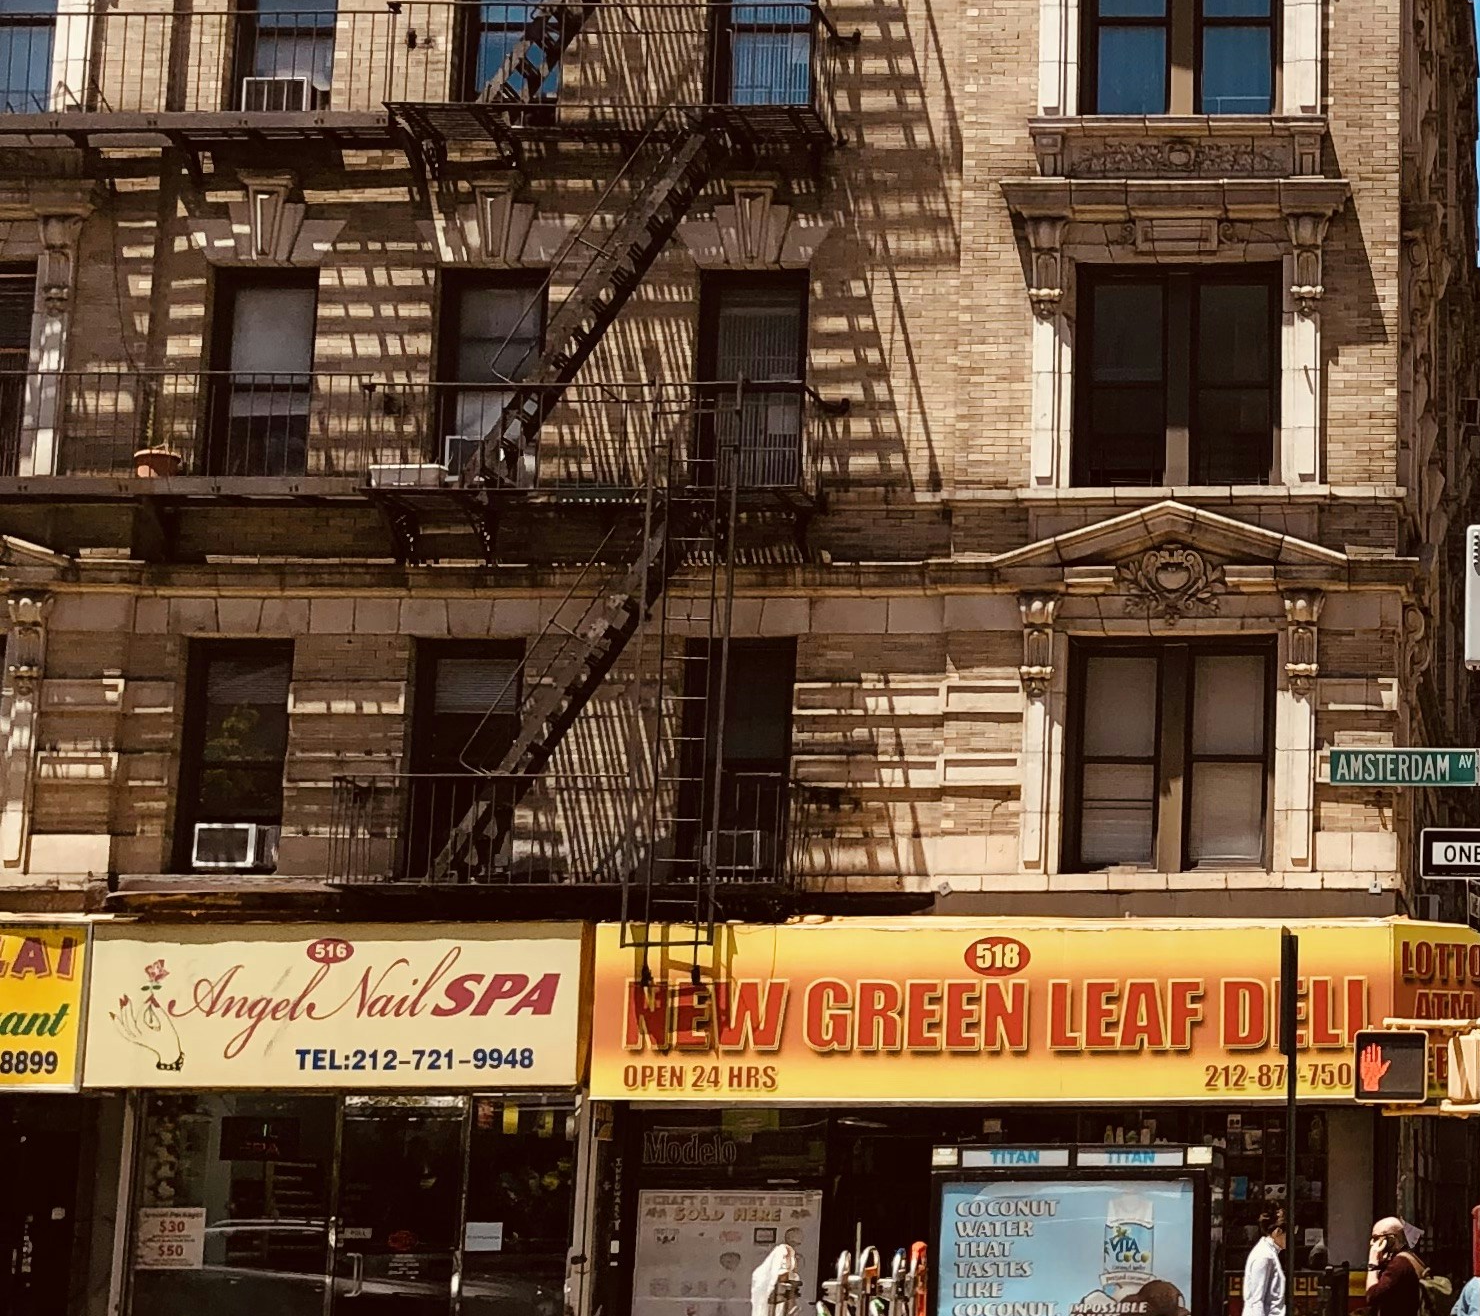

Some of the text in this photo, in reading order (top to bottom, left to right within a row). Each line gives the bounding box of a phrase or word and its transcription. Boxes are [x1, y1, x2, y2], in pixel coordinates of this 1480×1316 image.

[1336, 753, 1473, 781] AMSTERDAM AV
[0, 937, 76, 980] AI
[314, 944, 347, 958] 516
[975, 942, 1020, 969] 518
[168, 946, 562, 1060] Angel Nail SPA
[1414, 989, 1476, 1019] ATM
[0, 1003, 70, 1037] ant
[622, 977, 790, 1052] NEW
[803, 977, 1030, 1052] GREEN
[1048, 976, 1204, 1051] LEAF
[295, 1047, 535, 1072] TEL:212-721-9948
[623, 1064, 778, 1090] OPEN 24 HRS
[1204, 1062, 1352, 1090] 212-87-750
[643, 1131, 737, 1166] Modelo
[990, 1149, 1040, 1164] TITAN
[1107, 1150, 1156, 1164] TITAN
[673, 1207, 783, 1222] SOLD HERE
[955, 1199, 1060, 1217] COCONUT
[159, 1219, 186, 1233] $30
[954, 1221, 1034, 1237] WATER
[158, 1244, 184, 1258] $50
[953, 1240, 1014, 1258] THAT
[1108, 1235, 1140, 1253] VITA
[953, 1260, 1033, 1278] TASTES
[953, 1281, 1004, 1298] LIKE
[1068, 1302, 1148, 1314] IMPOSSIBLE
